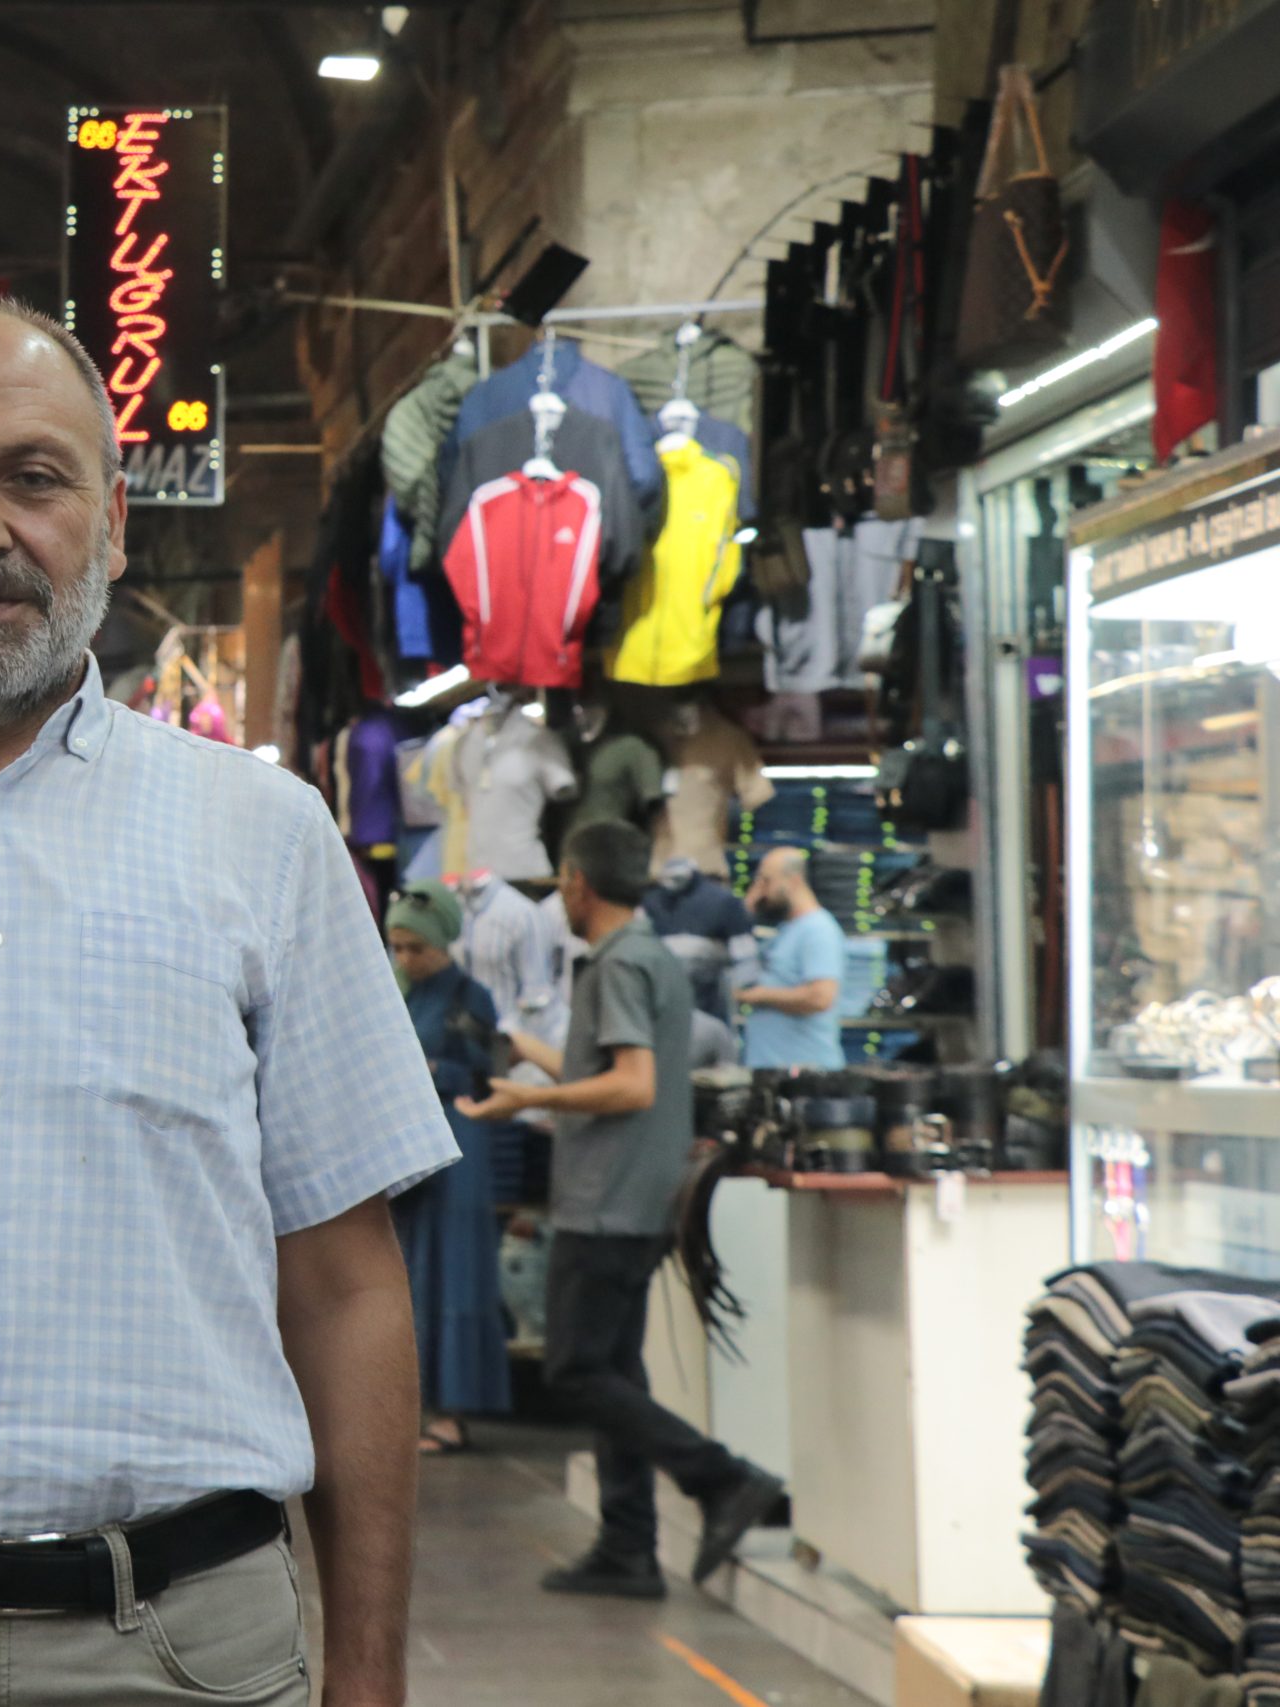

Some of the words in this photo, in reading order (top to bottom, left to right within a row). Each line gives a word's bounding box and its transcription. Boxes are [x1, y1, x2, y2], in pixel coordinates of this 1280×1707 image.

[78, 119, 117, 149] 66
[167, 400, 208, 431] 66
[125, 443, 212, 492] MAZ
